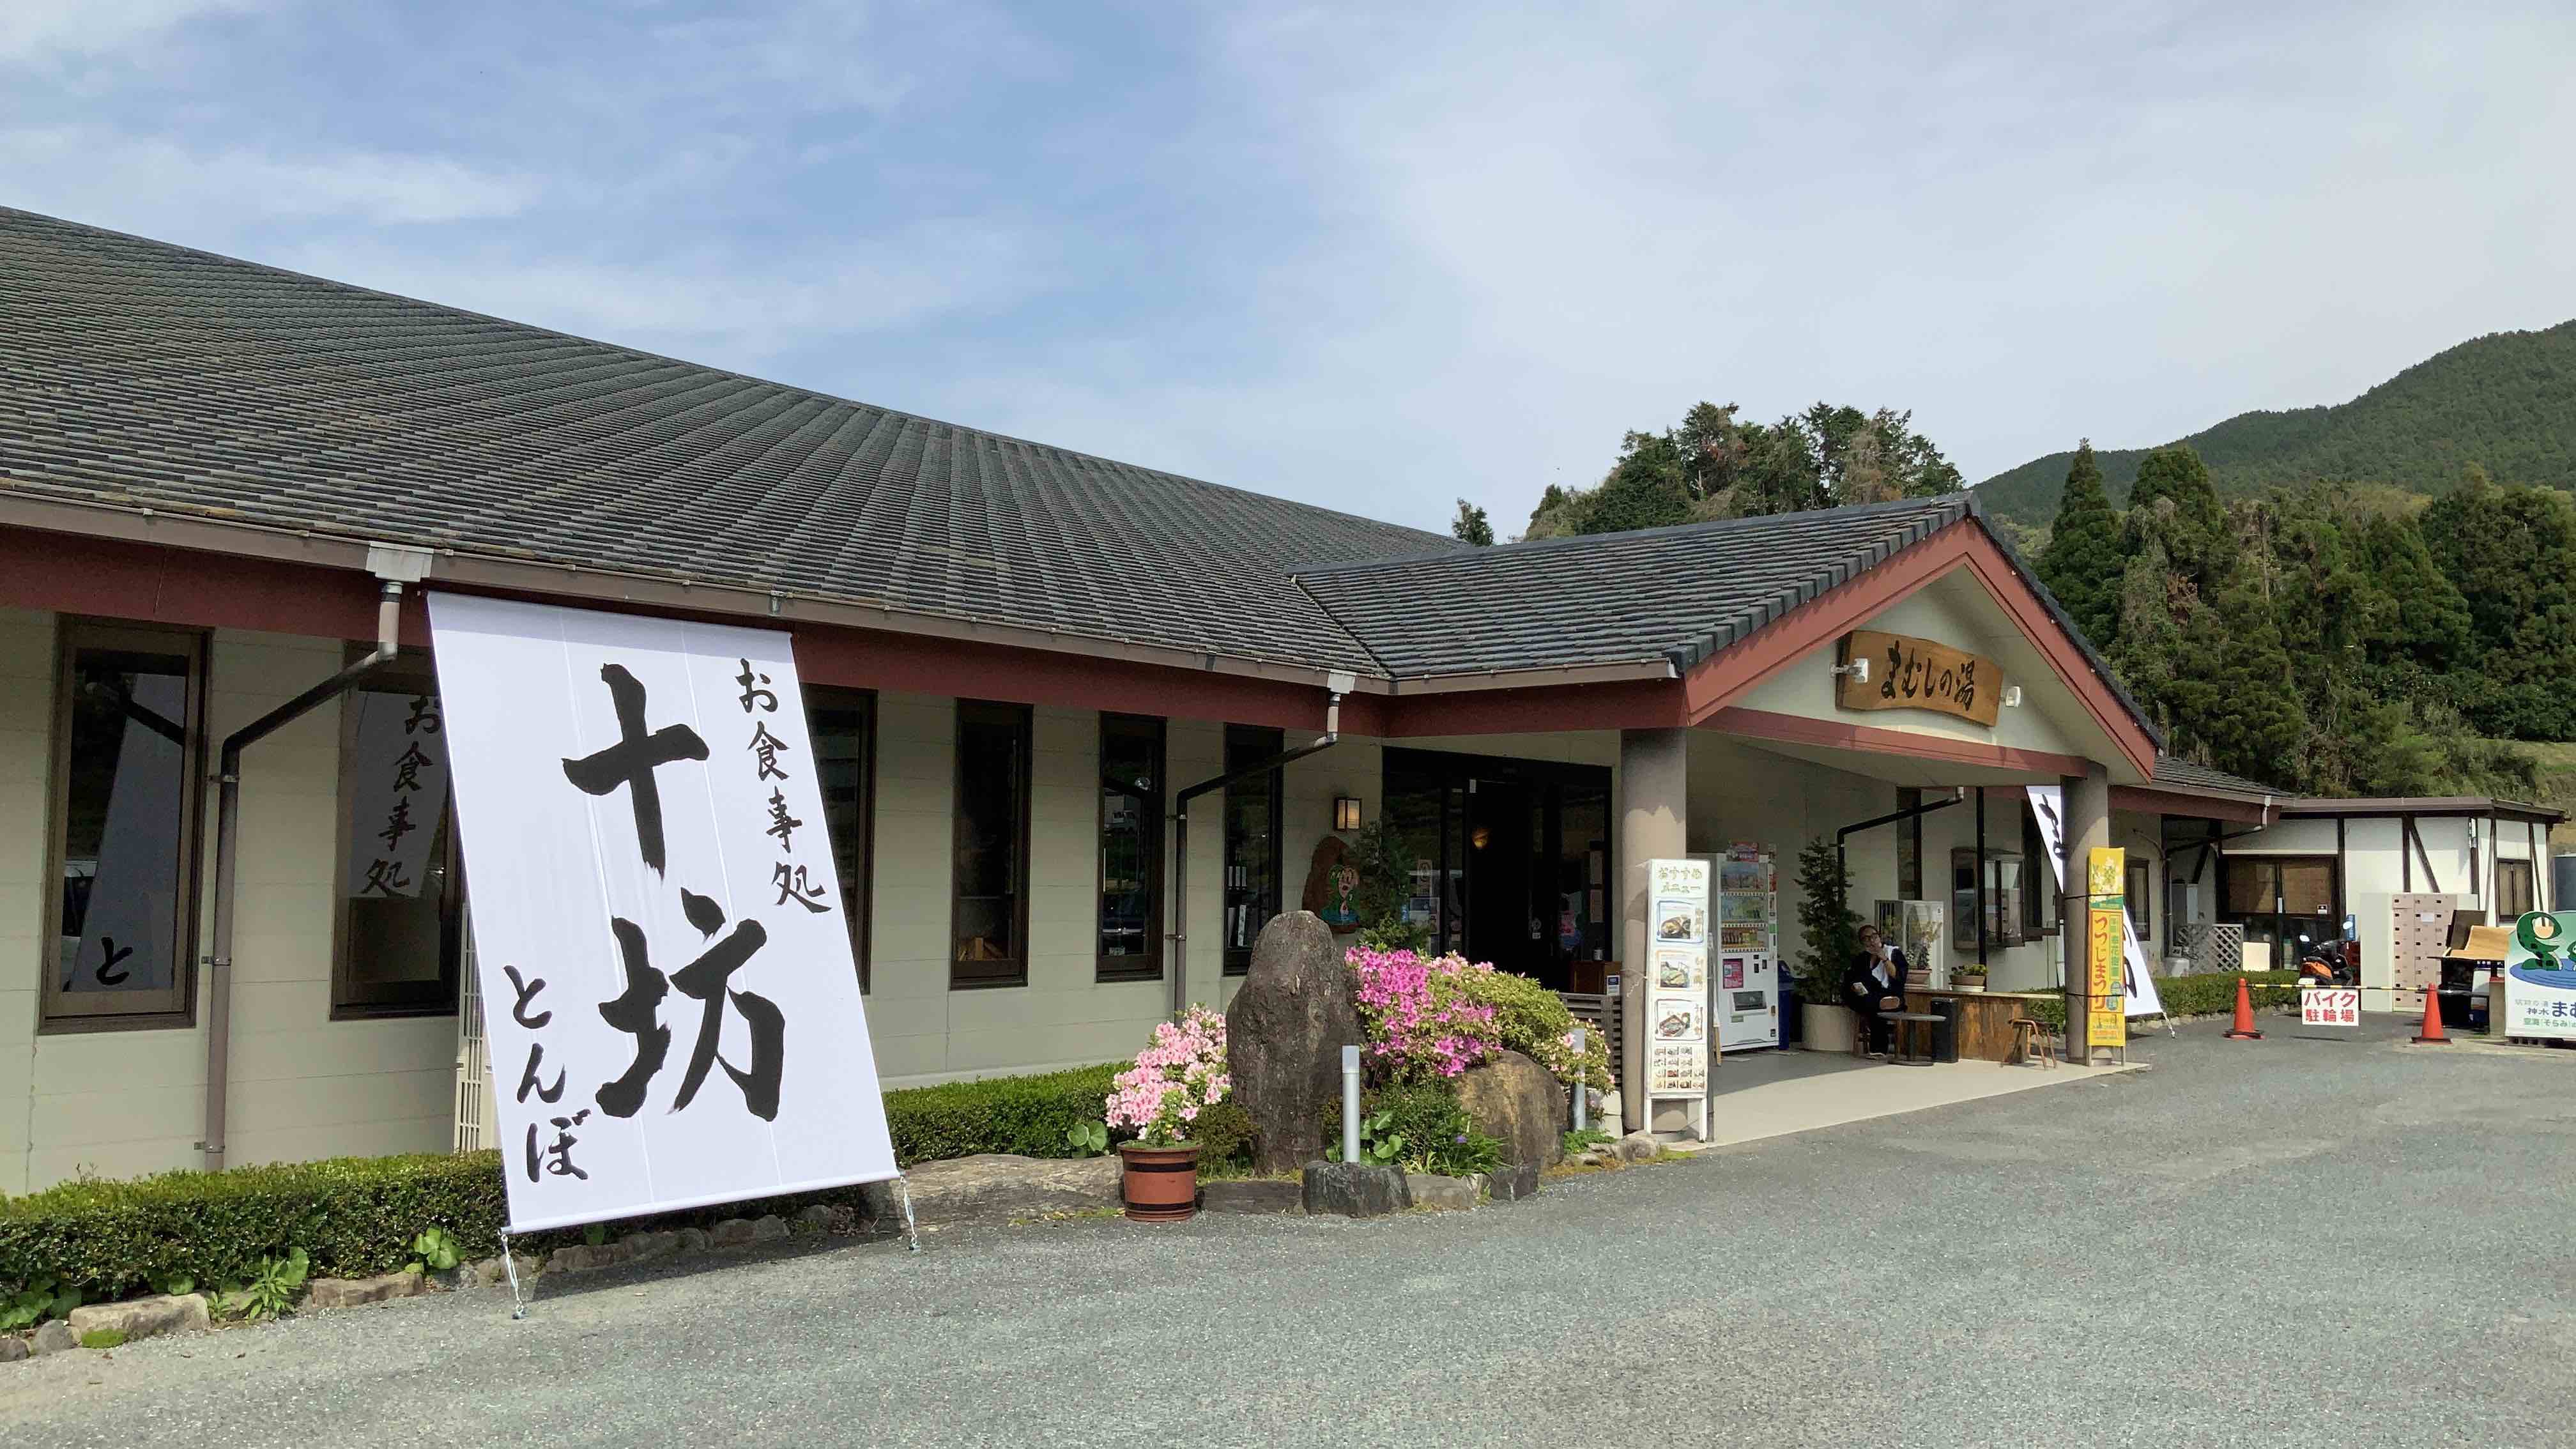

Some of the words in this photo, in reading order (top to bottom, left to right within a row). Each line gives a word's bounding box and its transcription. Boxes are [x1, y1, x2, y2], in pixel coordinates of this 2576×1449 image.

[1881, 640, 1975, 711] まむしの湯
[736, 657, 832, 914] お食事処
[562, 663, 785, 1122] 十坊
[2093, 916, 2108, 1009] つつじまつり
[2304, 991, 2356, 1008] バイク
[2306, 1009, 2354, 1022] 駐輪場
[503, 965, 591, 1183] とんぼ
